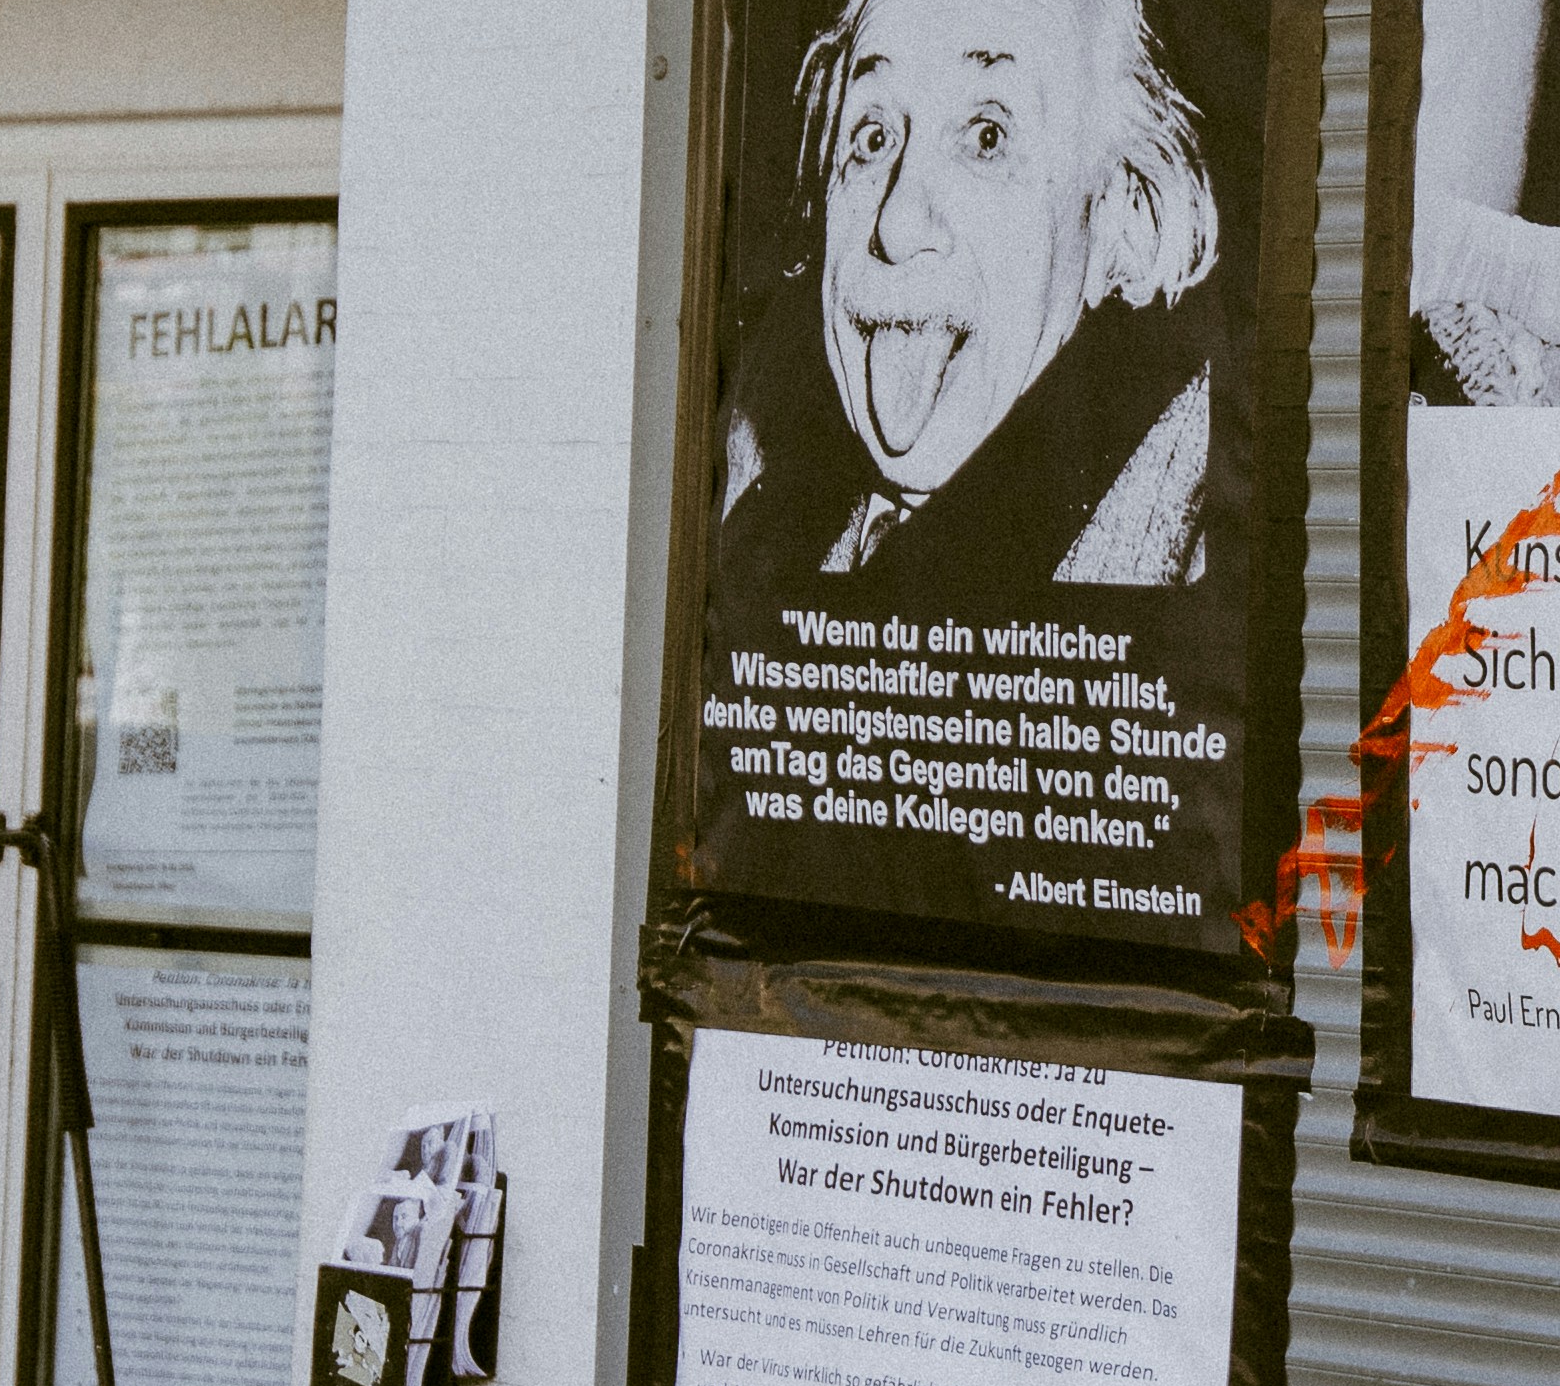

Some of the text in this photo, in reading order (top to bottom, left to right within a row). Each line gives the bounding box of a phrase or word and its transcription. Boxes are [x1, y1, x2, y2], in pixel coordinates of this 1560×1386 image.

[781, 609, 1133, 662] "Wenn du ein wirklicher
[731, 651, 1176, 718] Wissenschaftler werden willst,
[703, 694, 778, 732] denke
[1019, 712, 1102, 753] halbe
[1110, 717, 1227, 761] Stunde
[836, 744, 884, 782] das
[888, 748, 1029, 797] Gegenteil
[1035, 767, 1095, 799] von
[1104, 764, 1180, 811] dem,
[745, 791, 804, 821] was
[812, 787, 889, 827] deine
[894, 793, 1025, 845] Kollegen
[1093, 878, 1202, 916] Einstein
[1467, 987, 1514, 1025] Paul
[758, 1069, 1175, 1138] Untersuchungsausschuss oder Enquete-
[768, 1112, 1134, 1185] Kommission und Bürgerbeteiligung
[778, 1157, 1134, 1227] War der Shutdown ein Fehler?
